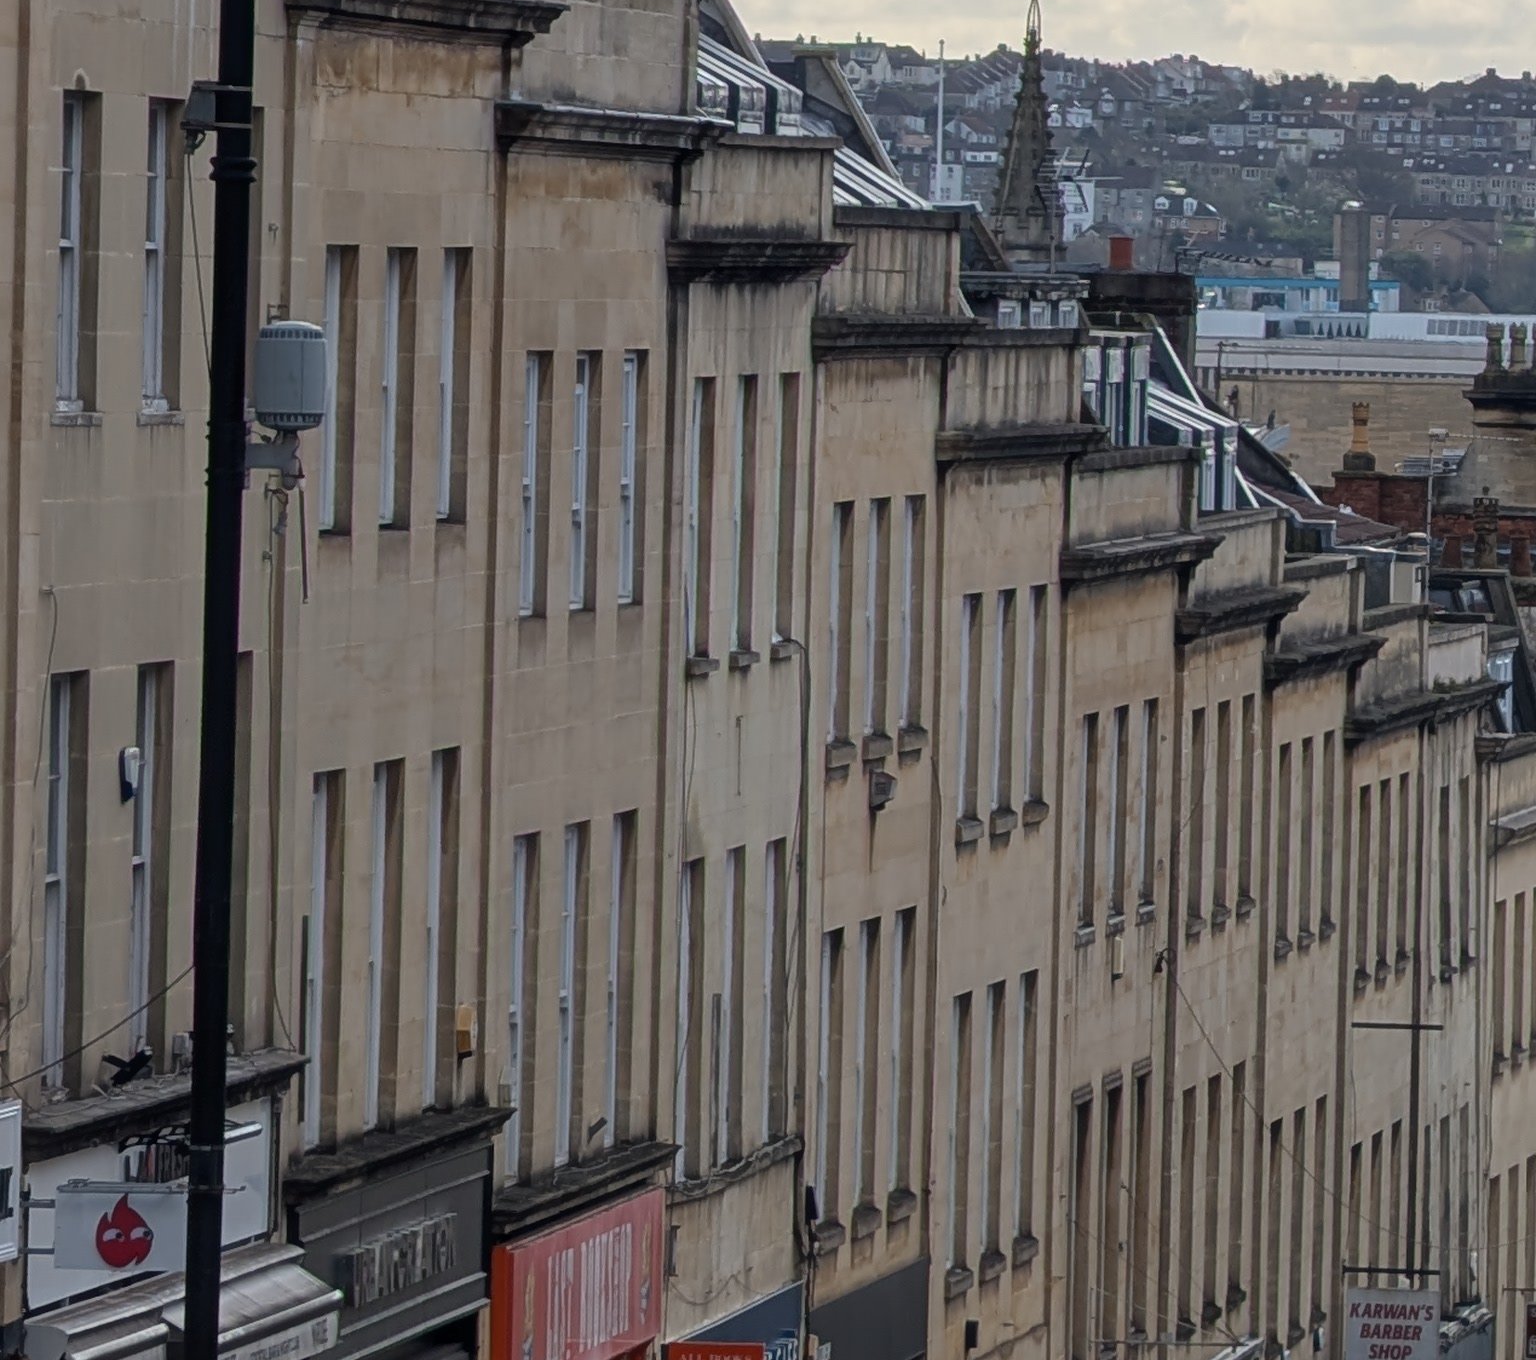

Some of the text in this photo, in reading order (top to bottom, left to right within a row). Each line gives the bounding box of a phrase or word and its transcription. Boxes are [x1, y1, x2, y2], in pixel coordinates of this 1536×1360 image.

[1350, 1302, 1434, 1321] KARWAN'S
[1360, 1323, 1423, 1340] BARBER
[1368, 1344, 1412, 1360] SHOP
